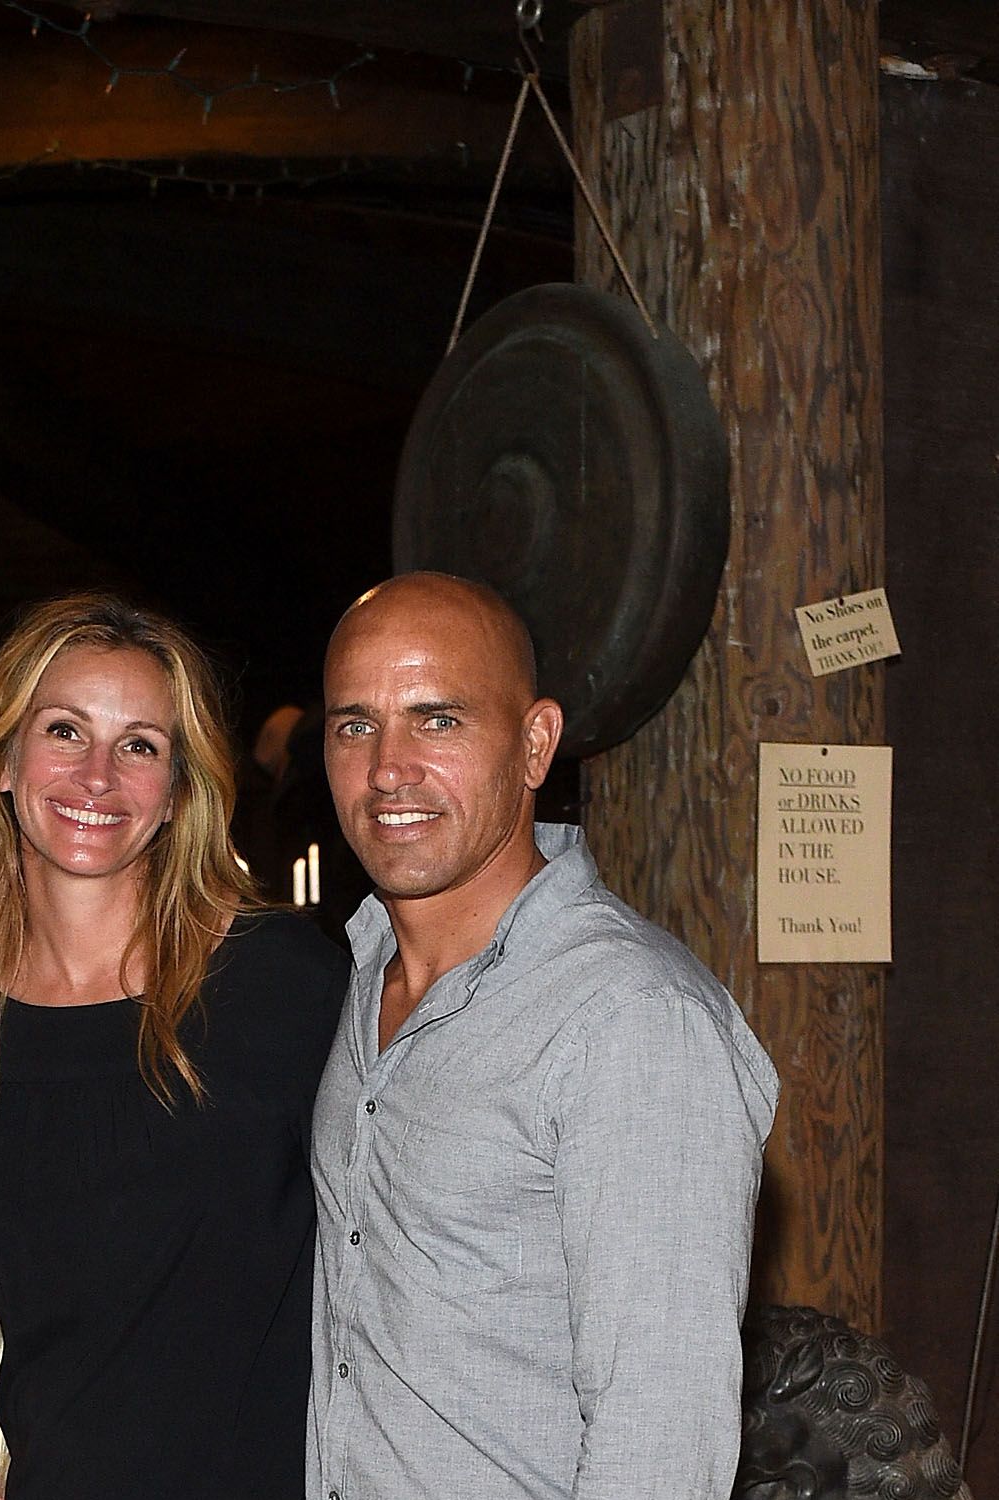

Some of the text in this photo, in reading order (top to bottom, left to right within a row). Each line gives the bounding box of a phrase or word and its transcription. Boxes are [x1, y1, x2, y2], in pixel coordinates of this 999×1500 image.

[805, 597, 883, 625] No Shoes on
[811, 623, 879, 650] the carpet.
[778, 767, 856, 785] NO FOOD
[778, 793, 861, 810] or DRINKS
[778, 817, 864, 835] ALLOWED
[778, 843, 834, 859] IN THE
[778, 867, 840, 884] HOUSE.
[778, 917, 862, 934] Thank You!
